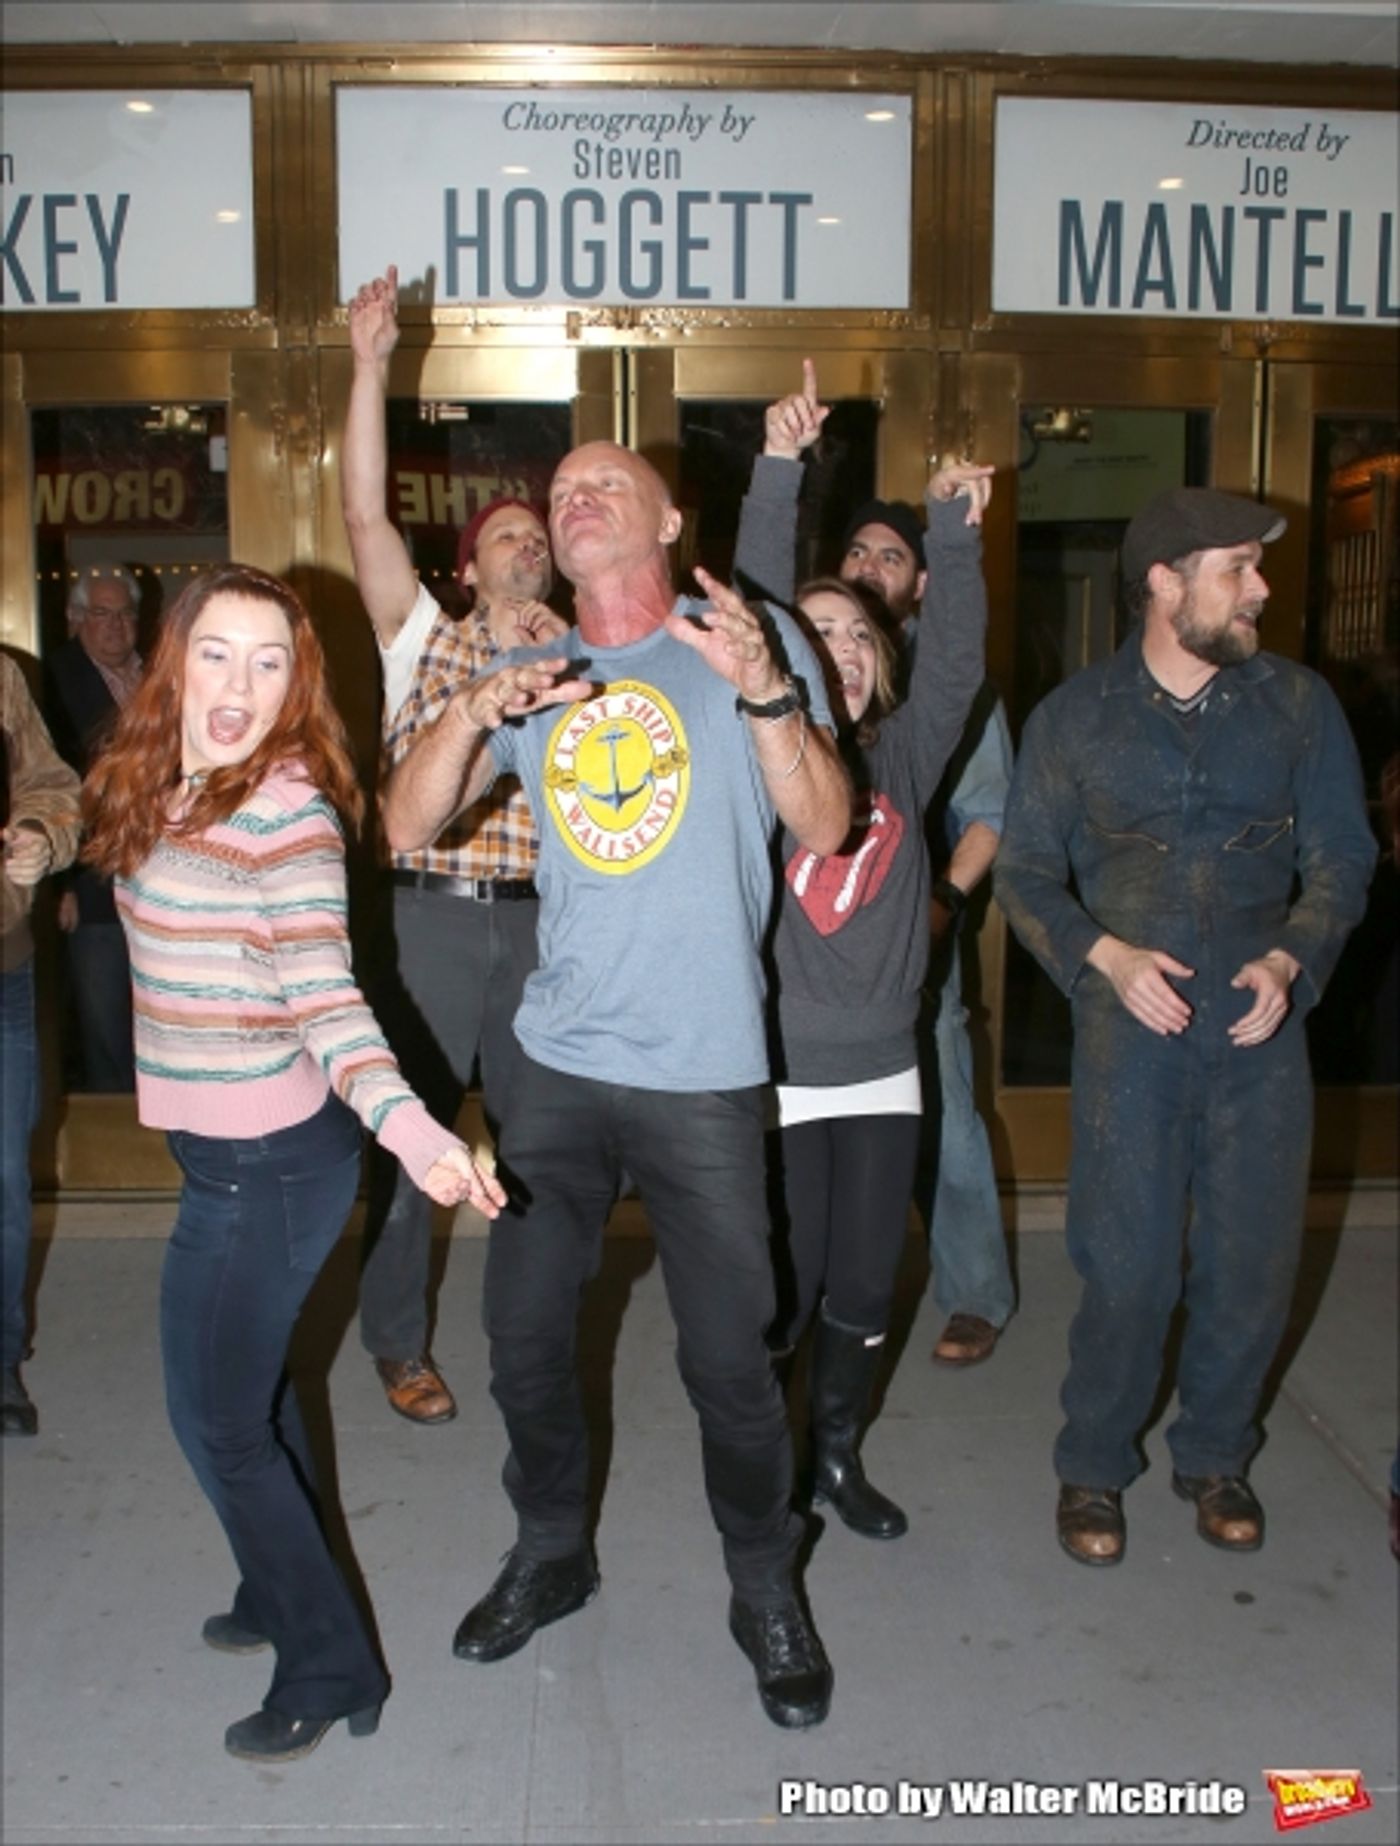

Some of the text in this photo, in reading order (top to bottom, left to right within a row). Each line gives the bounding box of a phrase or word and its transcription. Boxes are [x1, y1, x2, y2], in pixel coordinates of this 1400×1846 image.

[502, 101, 756, 143] Choreography by
[1185, 119, 1350, 161] Directed by
[574, 139, 682, 180] Steven
[1239, 156, 1288, 197] Joe
[443, 187, 814, 301] HOGGETT
[1057, 198, 1400, 318] MANTELL
[558, 696, 674, 756] LAST SHIP
[566, 789, 677, 857] WALLSEND
